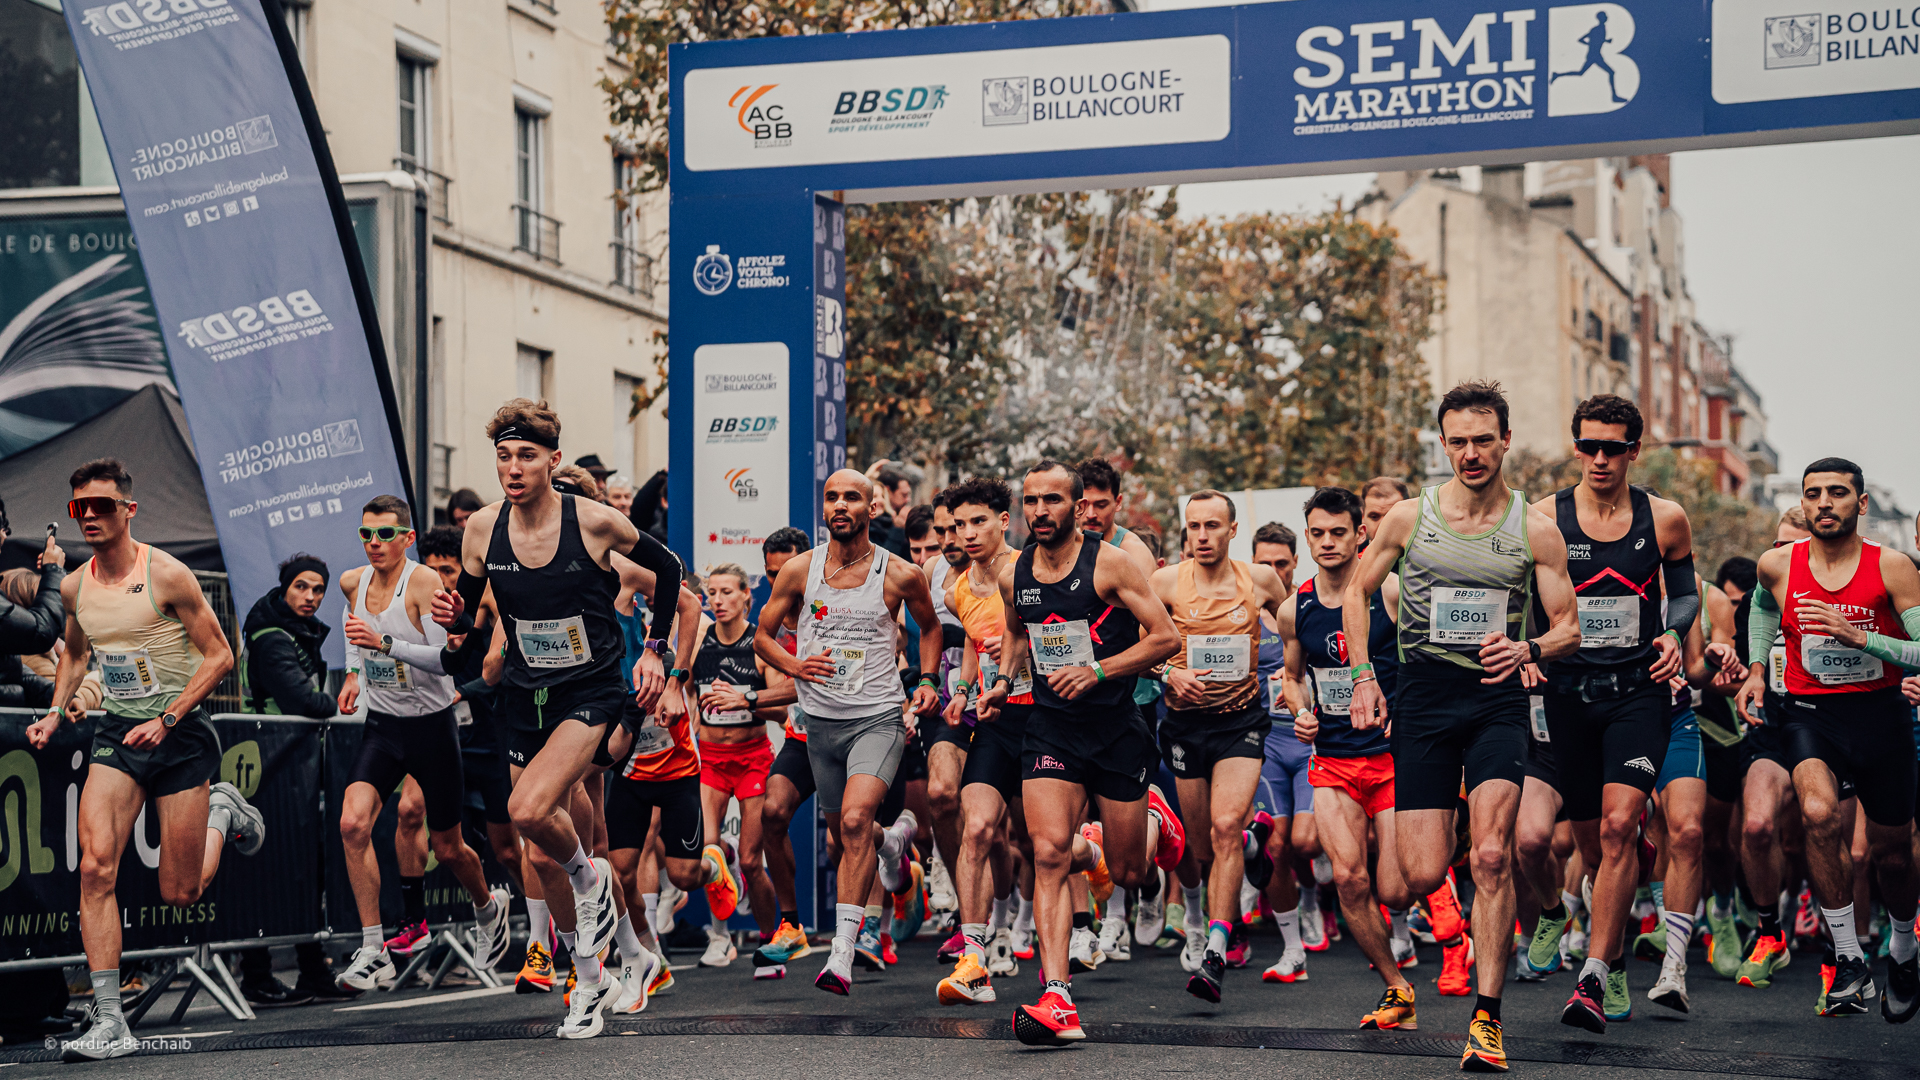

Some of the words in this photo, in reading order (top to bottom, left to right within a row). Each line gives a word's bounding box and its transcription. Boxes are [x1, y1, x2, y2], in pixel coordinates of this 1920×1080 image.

[1293, 9, 1536, 88] SEMI
[1033, 69, 1181, 97] BOULOGNE-
[833, 87, 929, 115] BBSD
[1294, 76, 1534, 123] MARATHON
[1033, 93, 1185, 121] BILLANCOURT
[747, 105, 784, 122] AC
[828, 124, 855, 133] SPORT
[1293, 118, 1401, 136] CHRISTIAN-GRANGER
[1402, 109, 1535, 128] BOULOGNE-BILLANCOURT
[755, 123, 792, 140] BB
[29, 233, 56, 254] DE
[737, 254, 786, 267] AFFOLEZ
[738, 266, 774, 277] VOTRE
[724, 382, 777, 391] BILLANCOURT
[709, 417, 767, 432] BBSD
[735, 479, 754, 488] AC
[738, 488, 758, 497] BB
[722, 527, 750, 537] Région
[1569, 550, 1591, 558] RMA
[1023, 595, 1041, 603] RMA
[1450, 609, 1488, 623] 6801
[1586, 618, 1621, 630] 2321
[532, 640, 569, 651] 7944
[568, 628, 581, 651] ELITE
[1043, 637, 1064, 645] ELITE
[843, 650, 862, 659] 16751
[1204, 653, 1234, 663] 8122
[1775, 656, 1783, 678] ELITE
[1822, 655, 1862, 667] 6032
[137, 660, 151, 682] ELITE
[109, 672, 136, 683] 3352
[1330, 688, 1354, 699] 753
[140, 902, 216, 927] FITNESS
